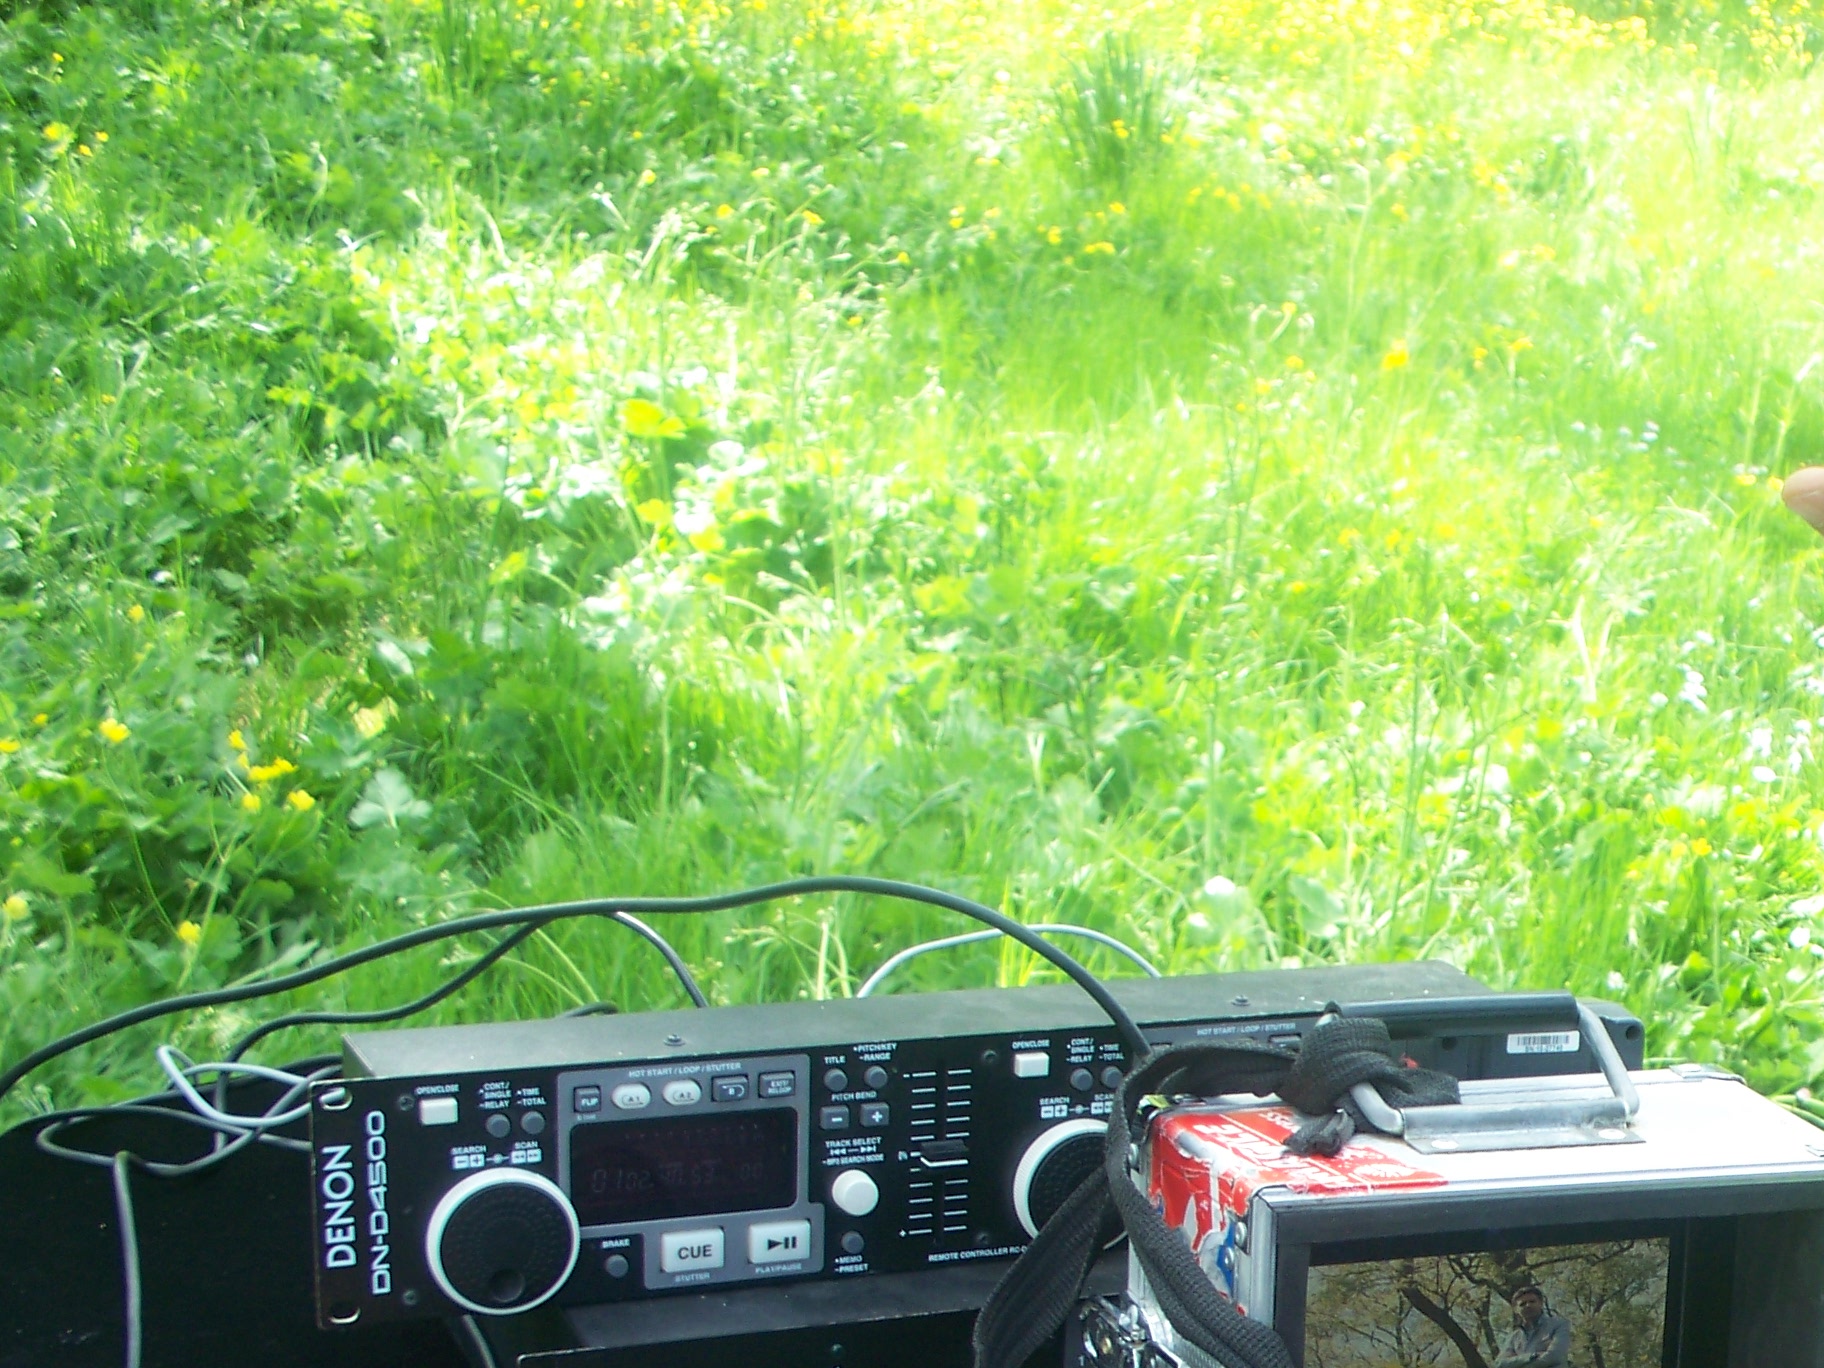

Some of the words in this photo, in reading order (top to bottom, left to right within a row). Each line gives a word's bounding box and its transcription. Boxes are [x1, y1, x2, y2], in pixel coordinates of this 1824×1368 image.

[824, 1055, 846, 1065] TITLE
[647, 1067, 673, 1077] START
[679, 1065, 700, 1075] LOOP
[706, 1062, 742, 1072] STUTTER
[522, 1087, 540, 1096] TIME
[831, 1092, 854, 1102] PITCH
[855, 1090, 877, 1100] BEND
[522, 1097, 547, 1107] TOTAL
[514, 1141, 539, 1150] SCAN
[825, 1139, 851, 1149] TRACK
[852, 1136, 882, 1146] SELECT
[451, 1145, 487, 1156] SEARCH
[322, 1144, 357, 1269] DENON
[366, 1110, 391, 1295] DN-D4500
[602, 1238, 631, 1249] BRAKE
[677, 1244, 713, 1261] CUE
[928, 1252, 959, 1262] REMOTE
[960, 1247, 1009, 1260] CONTROLLER
[839, 1255, 863, 1264] MEMO
[838, 1263, 869, 1273] PRESET
